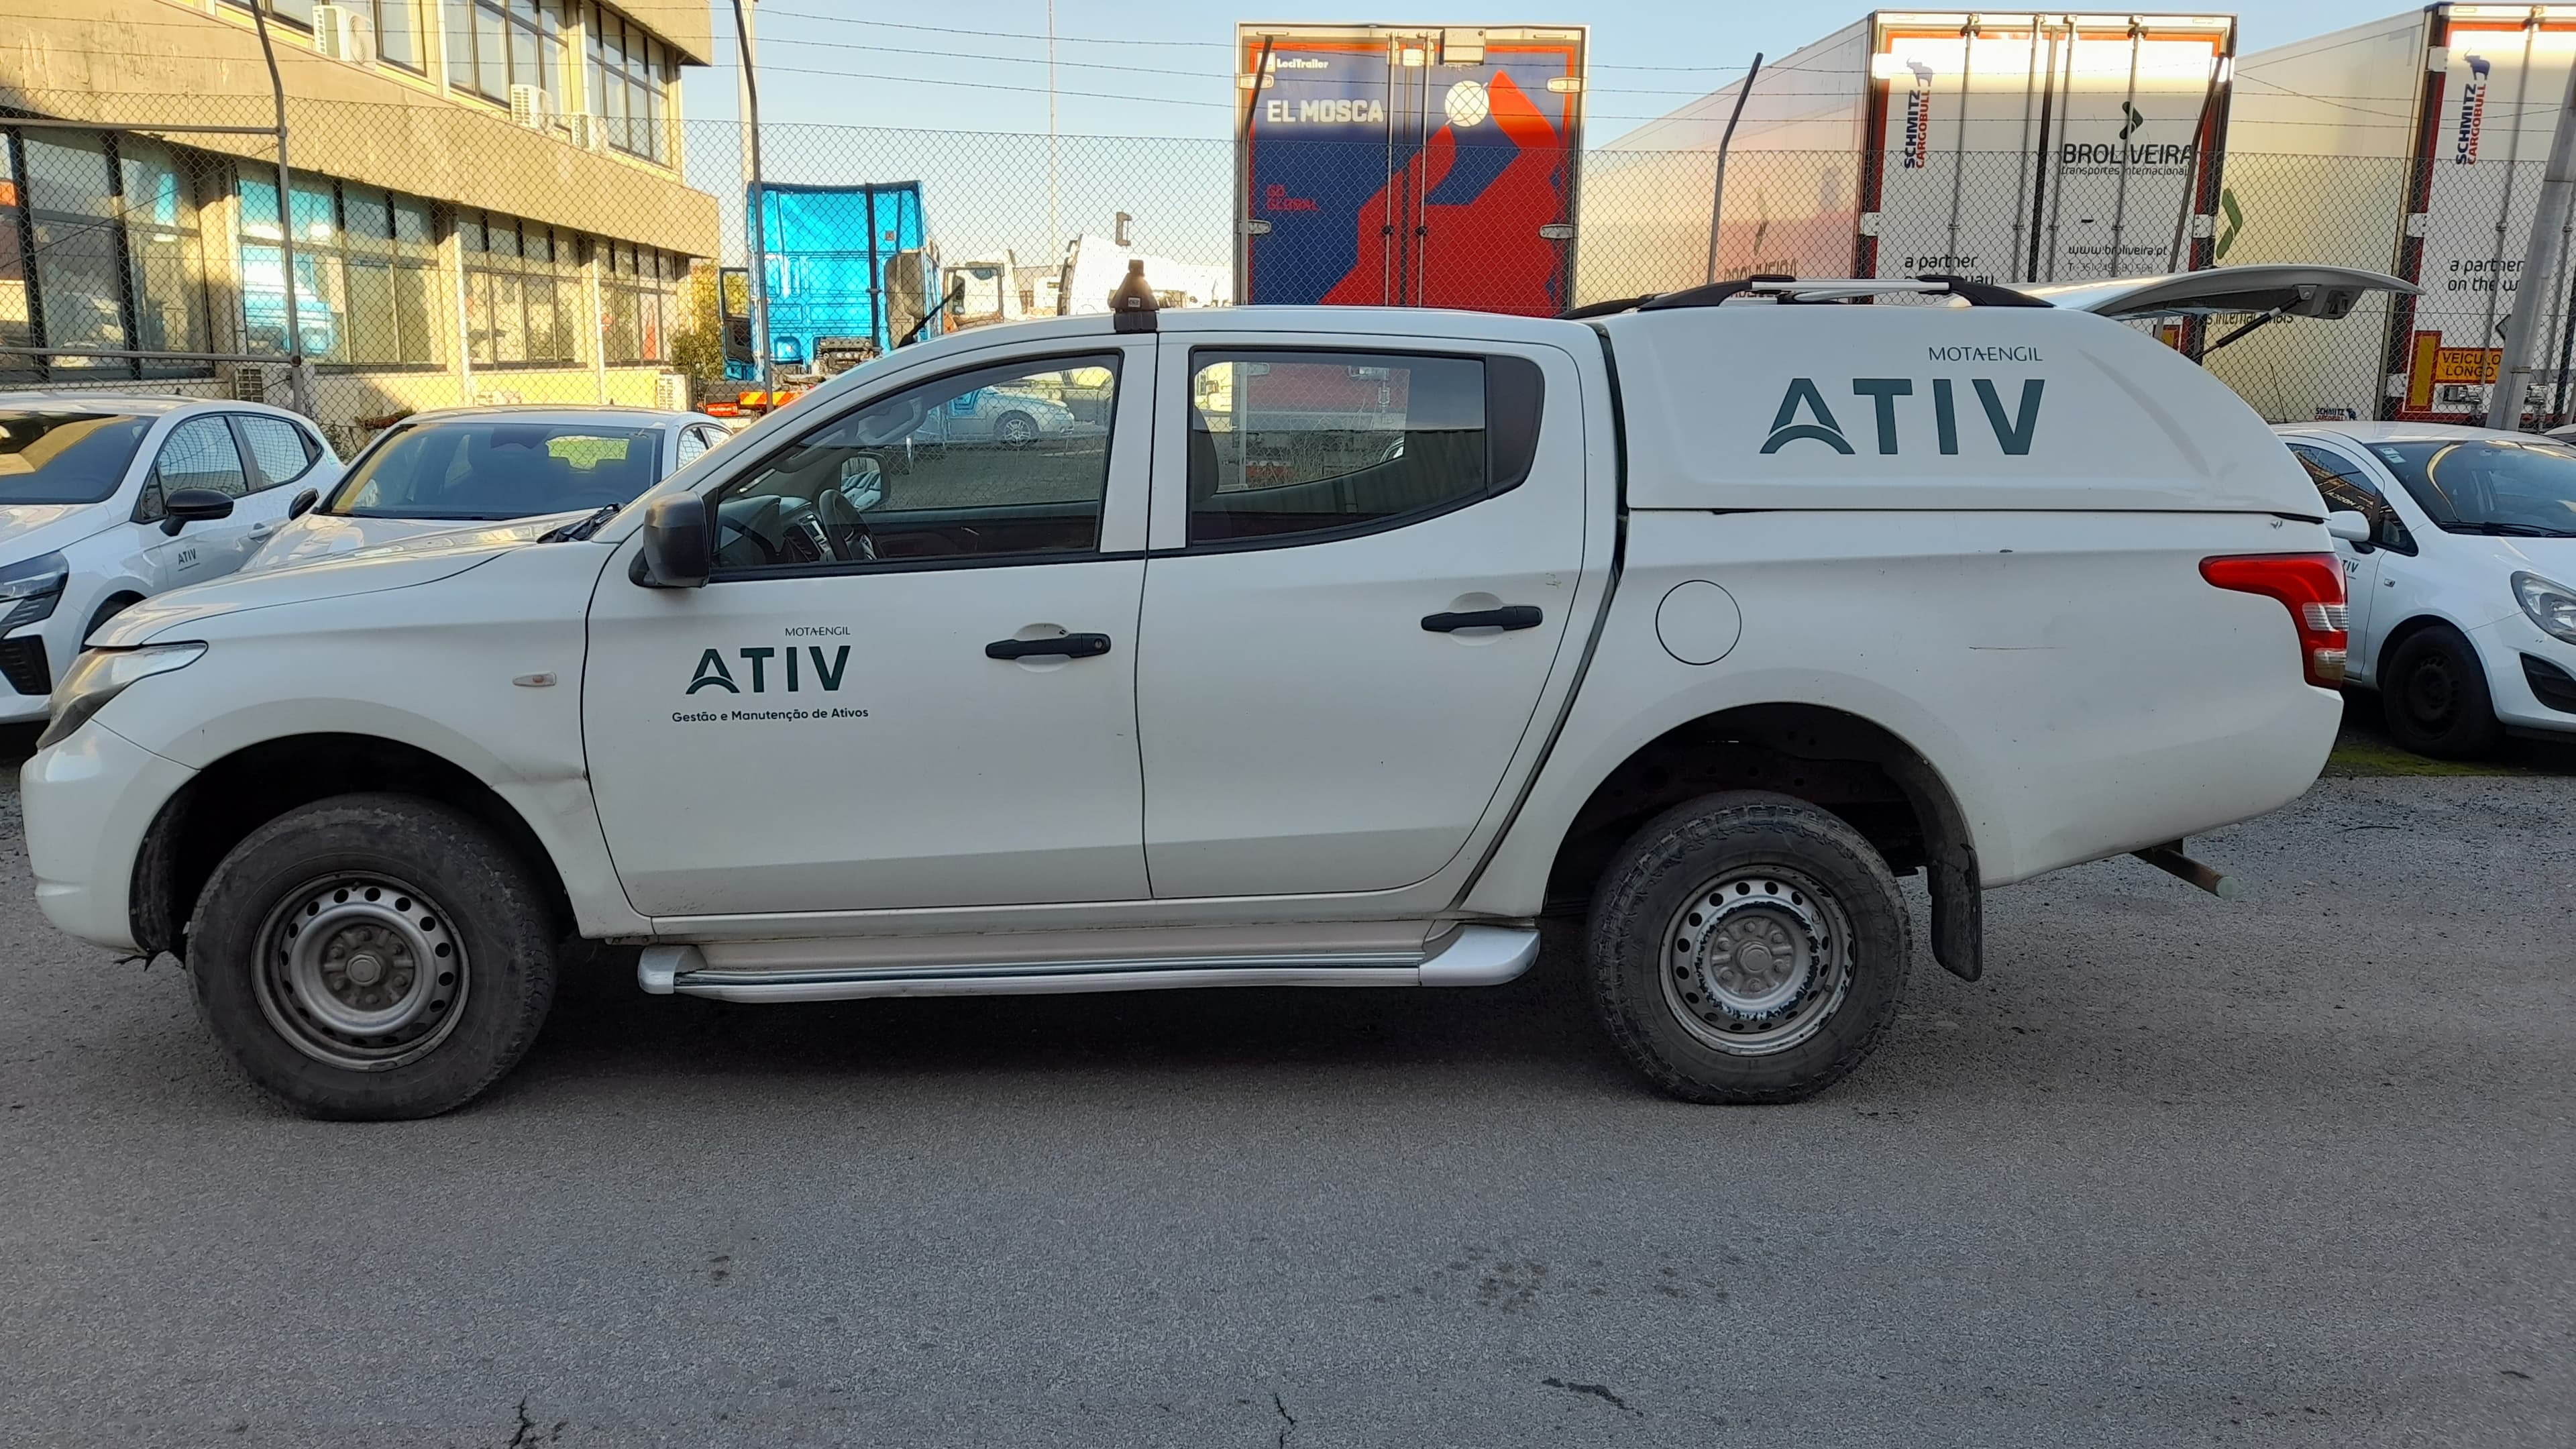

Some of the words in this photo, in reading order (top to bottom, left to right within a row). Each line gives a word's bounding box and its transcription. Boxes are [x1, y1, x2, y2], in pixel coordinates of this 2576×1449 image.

[1267, 99, 1296, 123] EL
[1299, 99, 1385, 123] MOSCA
[1904, 89, 1921, 169] SCHMITZ
[1915, 89, 1930, 169] CARGOBULL
[2455, 83, 2477, 165] SCHMITZ
[2467, 83, 2486, 165] CARGOBULL
[2063, 143, 2192, 164] BROLVEIRA
[1904, 256, 1914, 268] a
[1919, 254, 1979, 271] partner
[2449, 260, 2459, 272] a
[2463, 258, 2525, 276] partner
[2448, 279, 2467, 291] on
[2472, 276, 2496, 291] the
[2445, 365, 2495, 378] LONGO
[1759, 377, 2045, 455] ATIV
[178, 547, 197, 566] ATIV
[685, 645, 851, 695] ATIV
[672, 711, 717, 722] Gestão
[720, 713, 729, 721] e
[731, 709, 808, 722] Manutenção
[812, 708, 828, 719] de
[831, 707, 869, 718] Ativos
